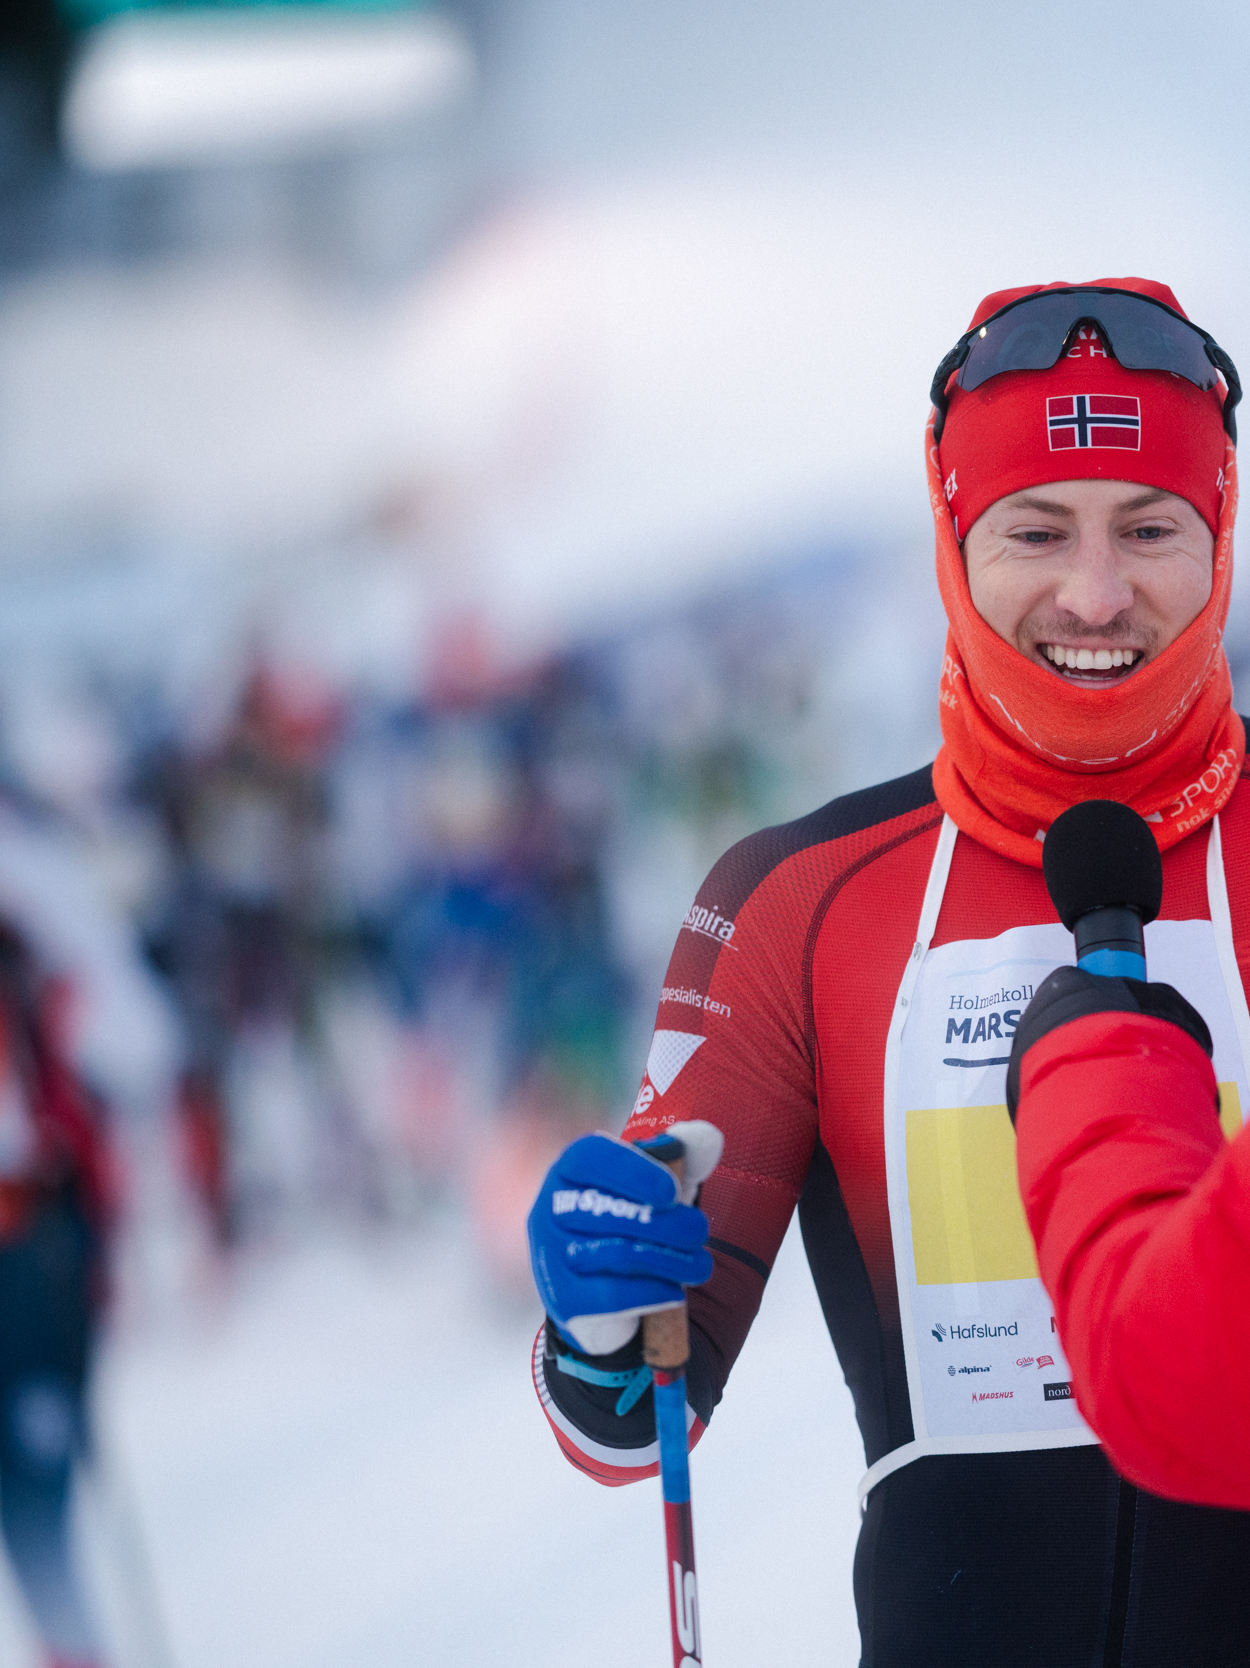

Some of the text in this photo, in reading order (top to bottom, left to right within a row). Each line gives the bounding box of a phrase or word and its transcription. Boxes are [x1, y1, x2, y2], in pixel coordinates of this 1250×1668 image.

[945, 1009, 1021, 1044] MARS
[659, 1115, 676, 1125] AS
[950, 1322, 1018, 1339] Hafslund
[958, 1366, 991, 1375] alpina
[979, 1391, 1014, 1401] MADSHUS
